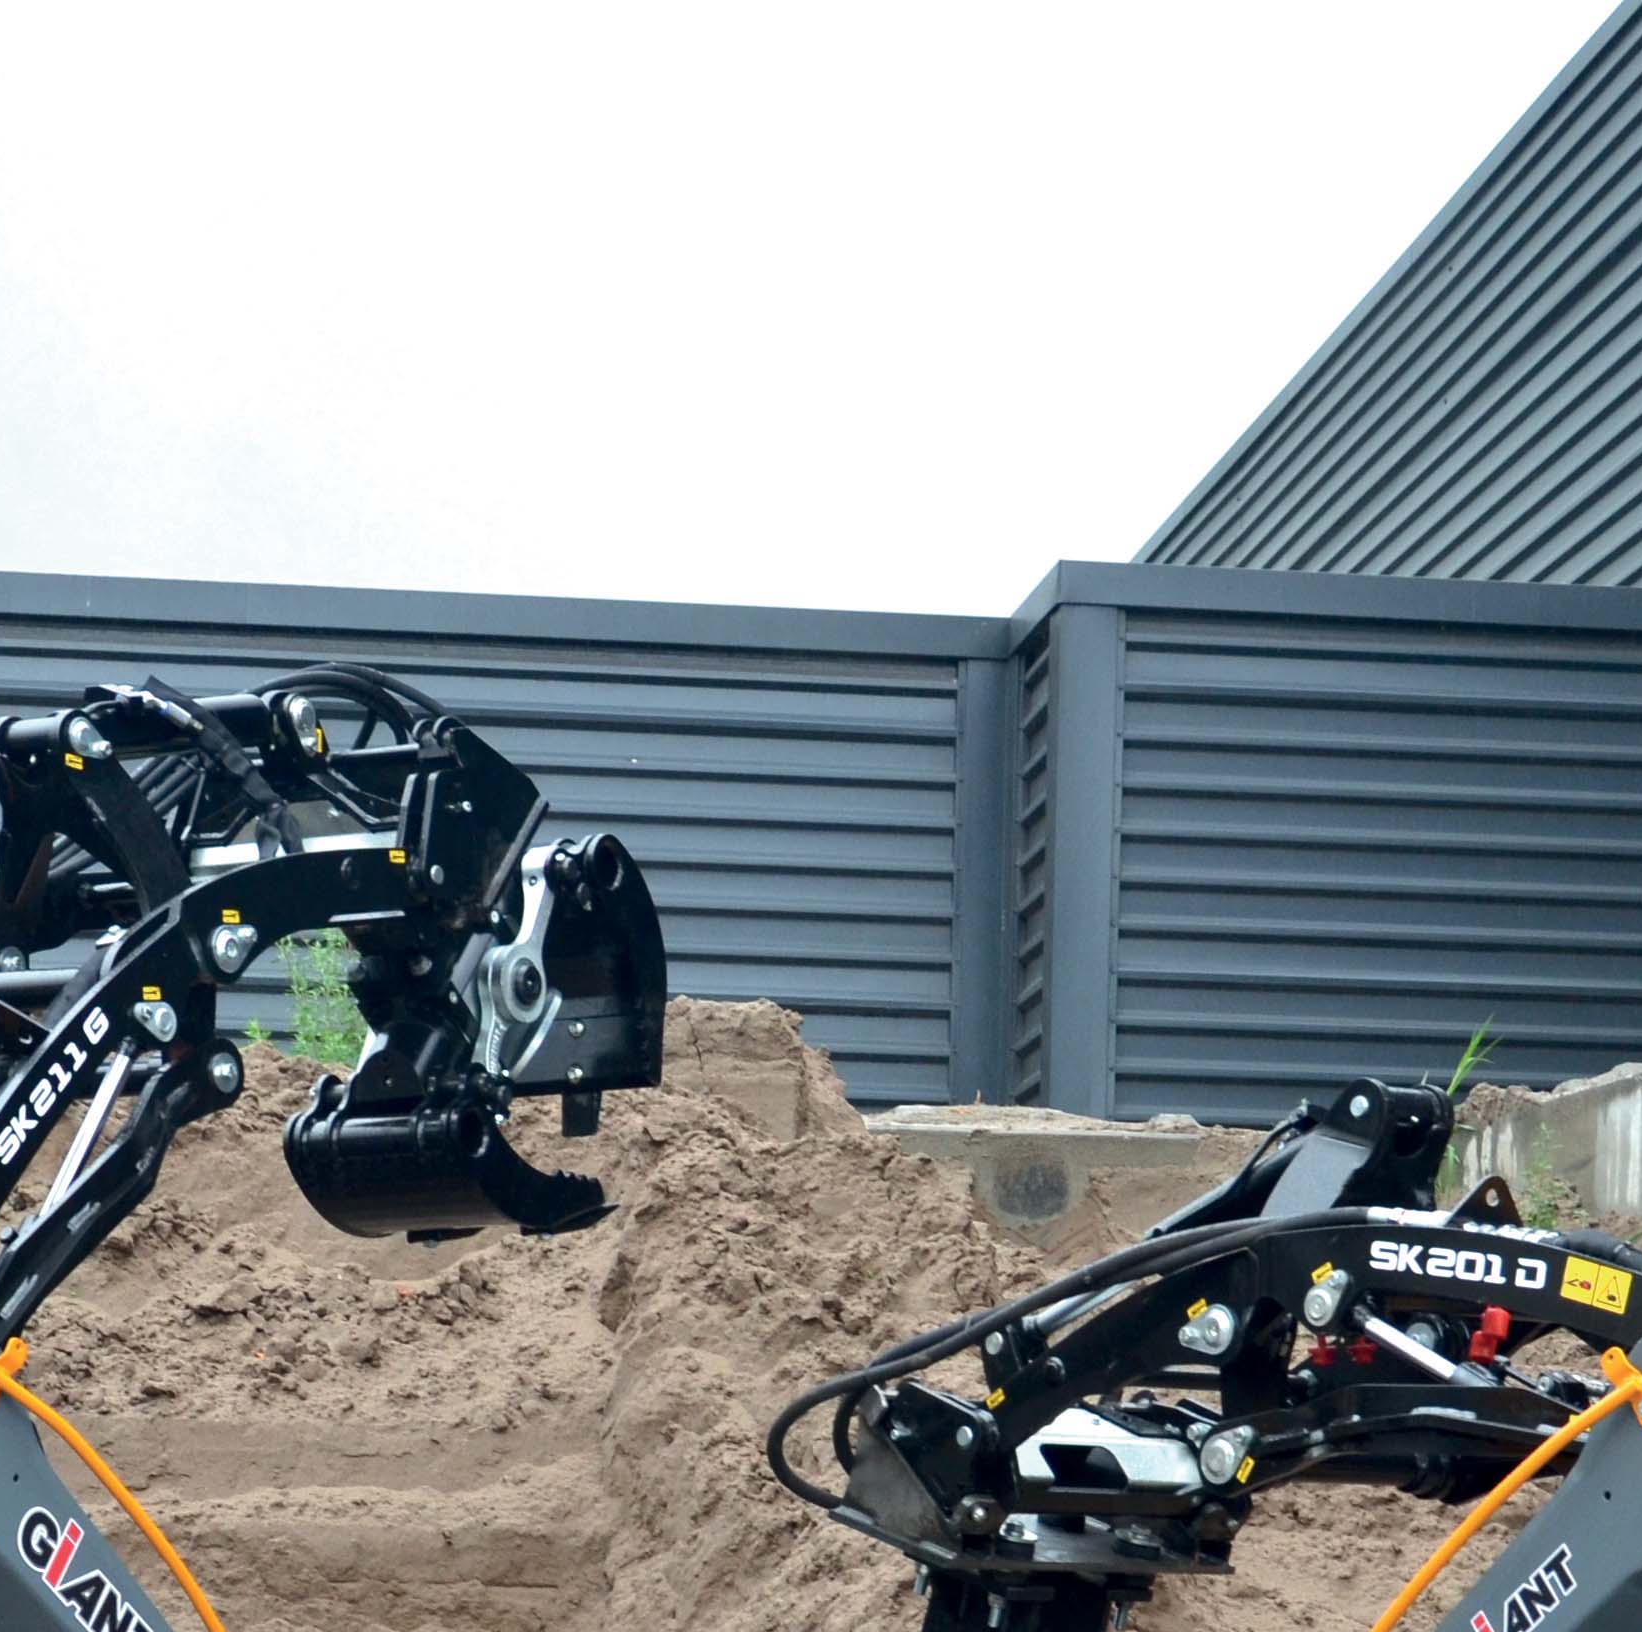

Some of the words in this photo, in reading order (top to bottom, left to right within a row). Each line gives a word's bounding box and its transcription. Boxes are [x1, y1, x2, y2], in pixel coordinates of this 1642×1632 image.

[83, 1006, 109, 1045] G
[1369, 1240, 1506, 1285] SK201
[1514, 1257, 1548, 1290] D
